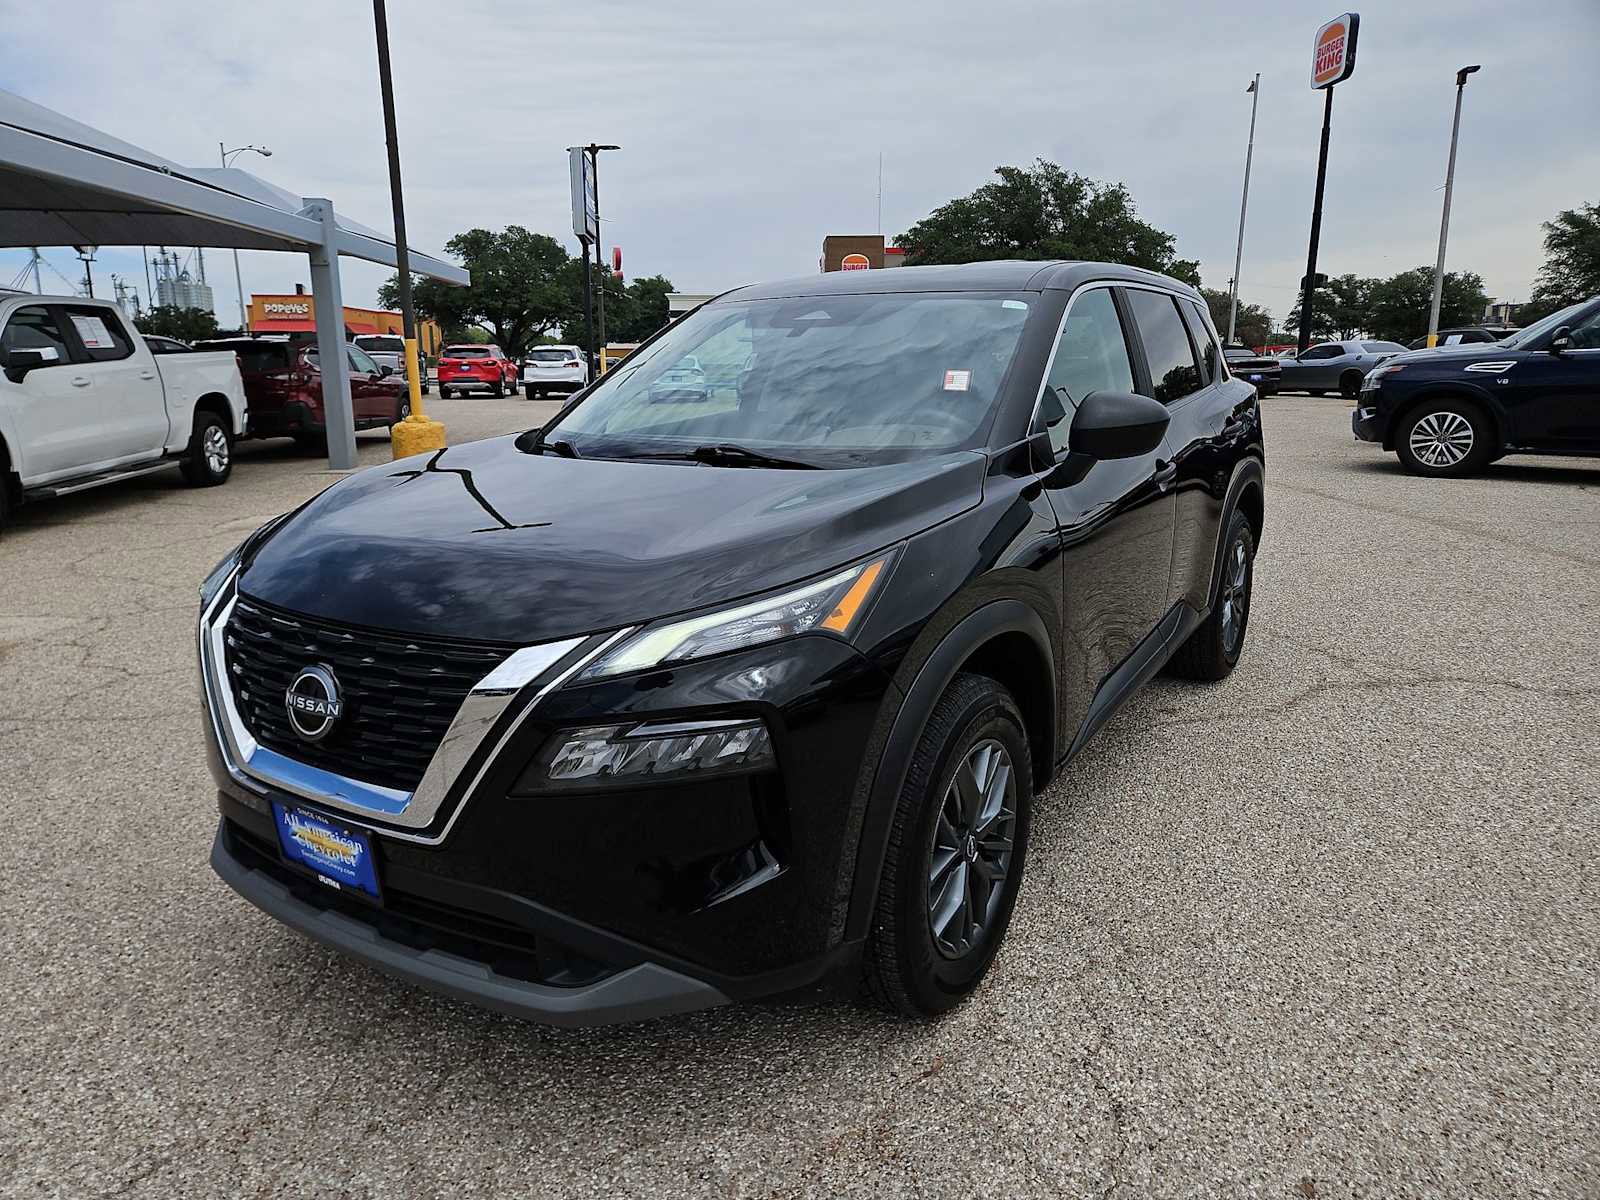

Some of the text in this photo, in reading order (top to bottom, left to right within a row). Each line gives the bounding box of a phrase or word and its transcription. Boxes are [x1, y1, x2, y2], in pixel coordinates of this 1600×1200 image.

[1317, 36, 1345, 59] BURGER
[1315, 49, 1343, 75] KING
[264, 304, 309, 313] POPEYES
[286, 690, 339, 715] NISSAN
[304, 821, 364, 853] American
[296, 834, 357, 867] Chevrolet
